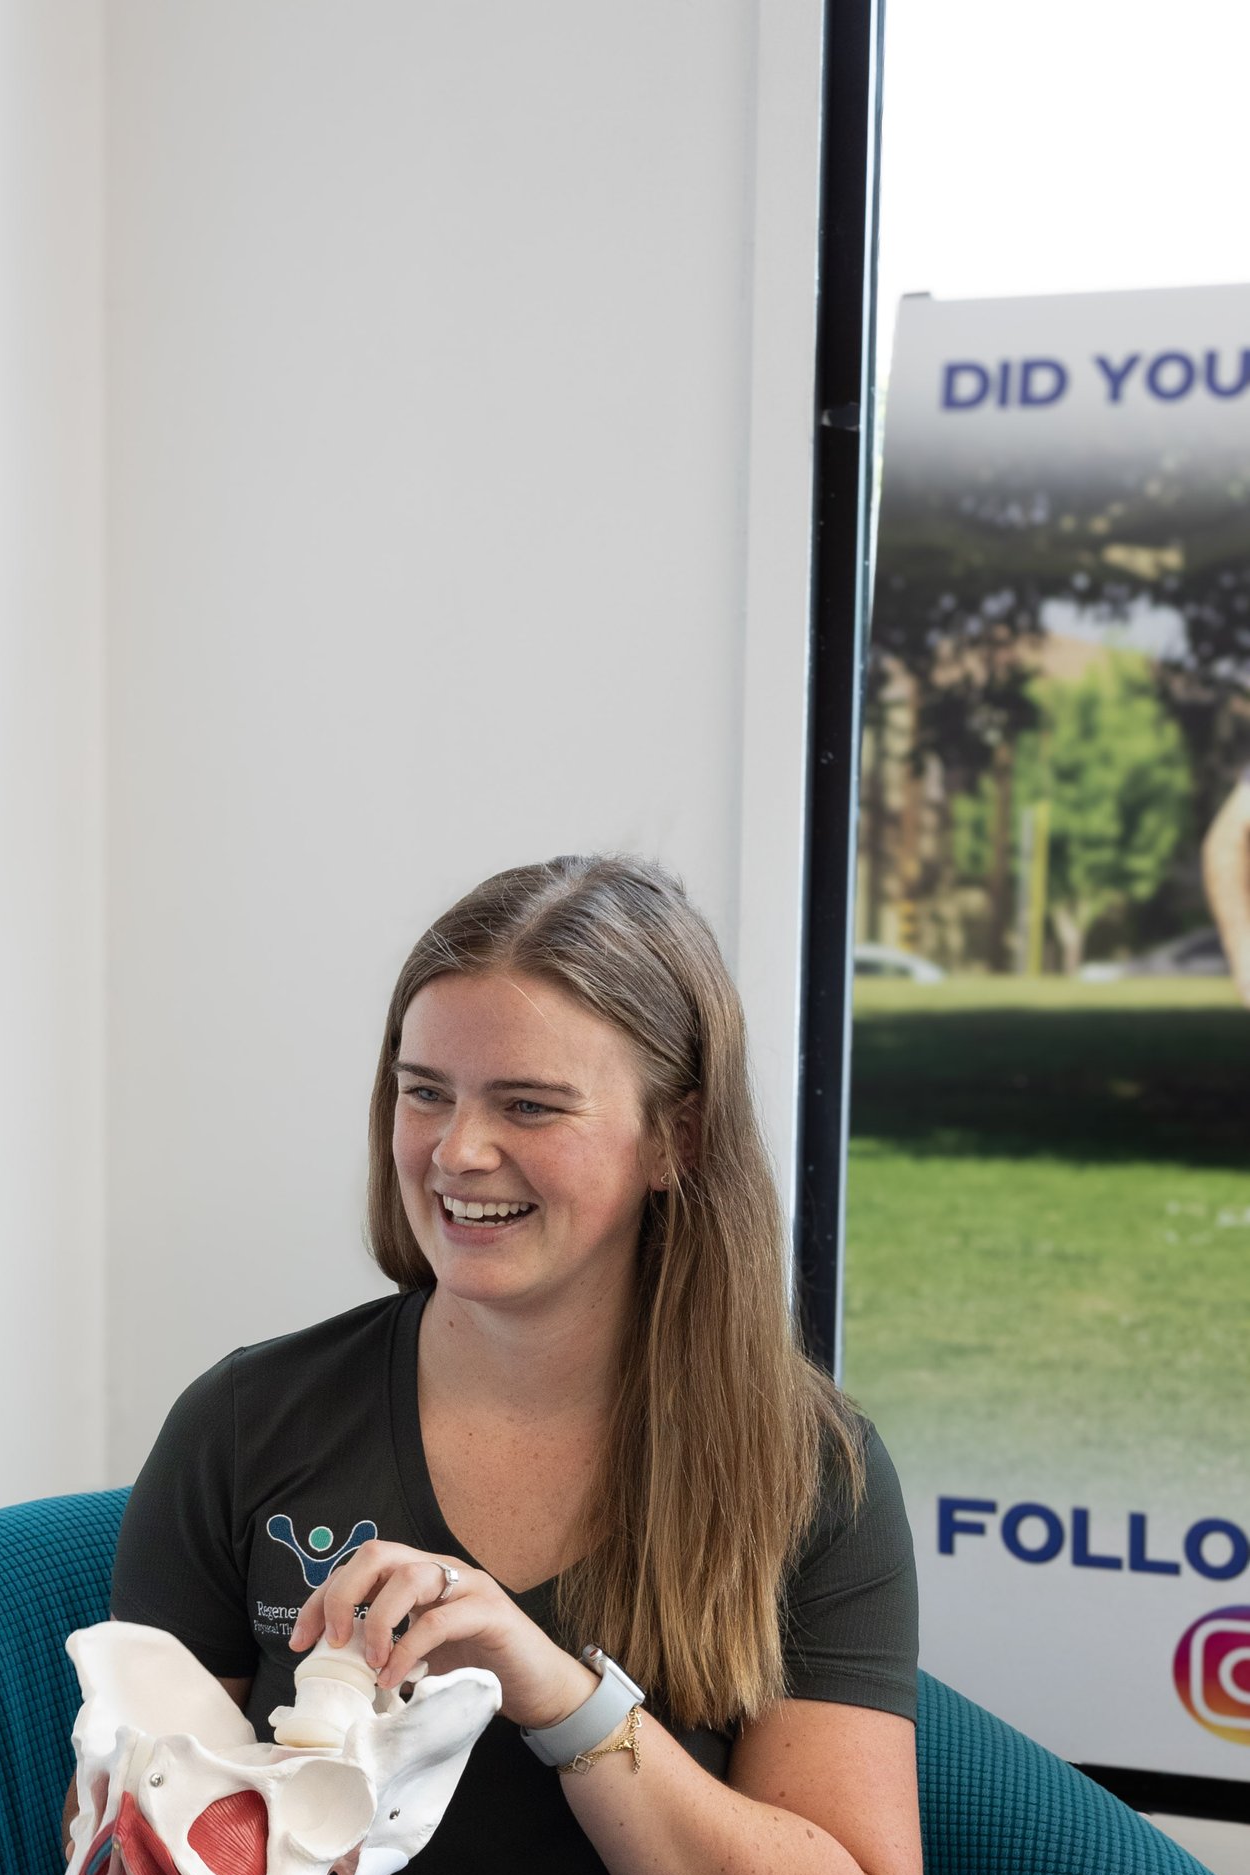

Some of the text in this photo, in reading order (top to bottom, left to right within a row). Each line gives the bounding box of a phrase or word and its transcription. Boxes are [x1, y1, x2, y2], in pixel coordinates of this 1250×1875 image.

[941, 347, 1250, 411] DID YOU
[936, 1495, 1250, 1582] FOLLO
